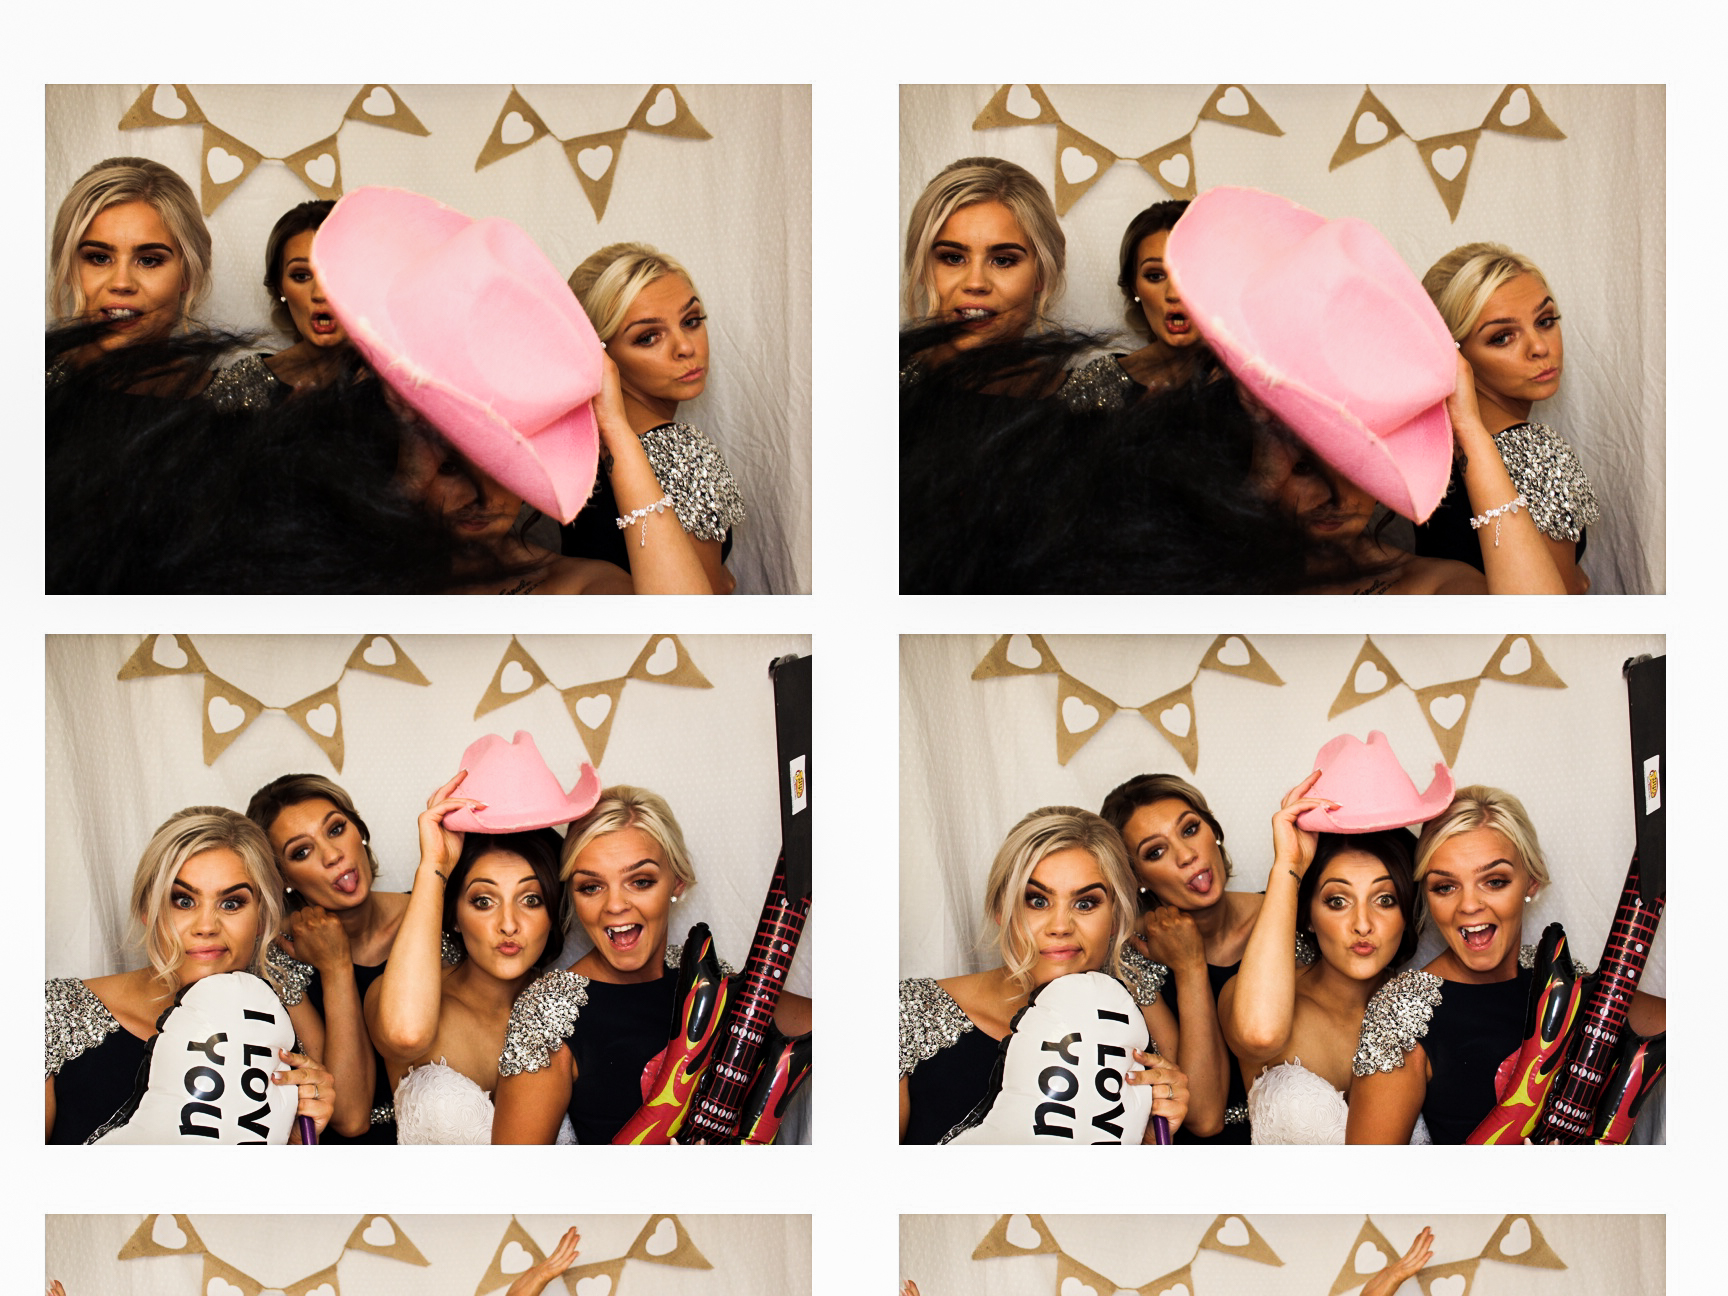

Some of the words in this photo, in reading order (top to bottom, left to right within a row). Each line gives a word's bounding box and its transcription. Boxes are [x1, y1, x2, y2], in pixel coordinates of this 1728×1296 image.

[243, 1008, 276, 1025] I
[1097, 1008, 1130, 1025] I
[237, 1043, 273, 1145] LOV
[1091, 1043, 1127, 1145] LOV
